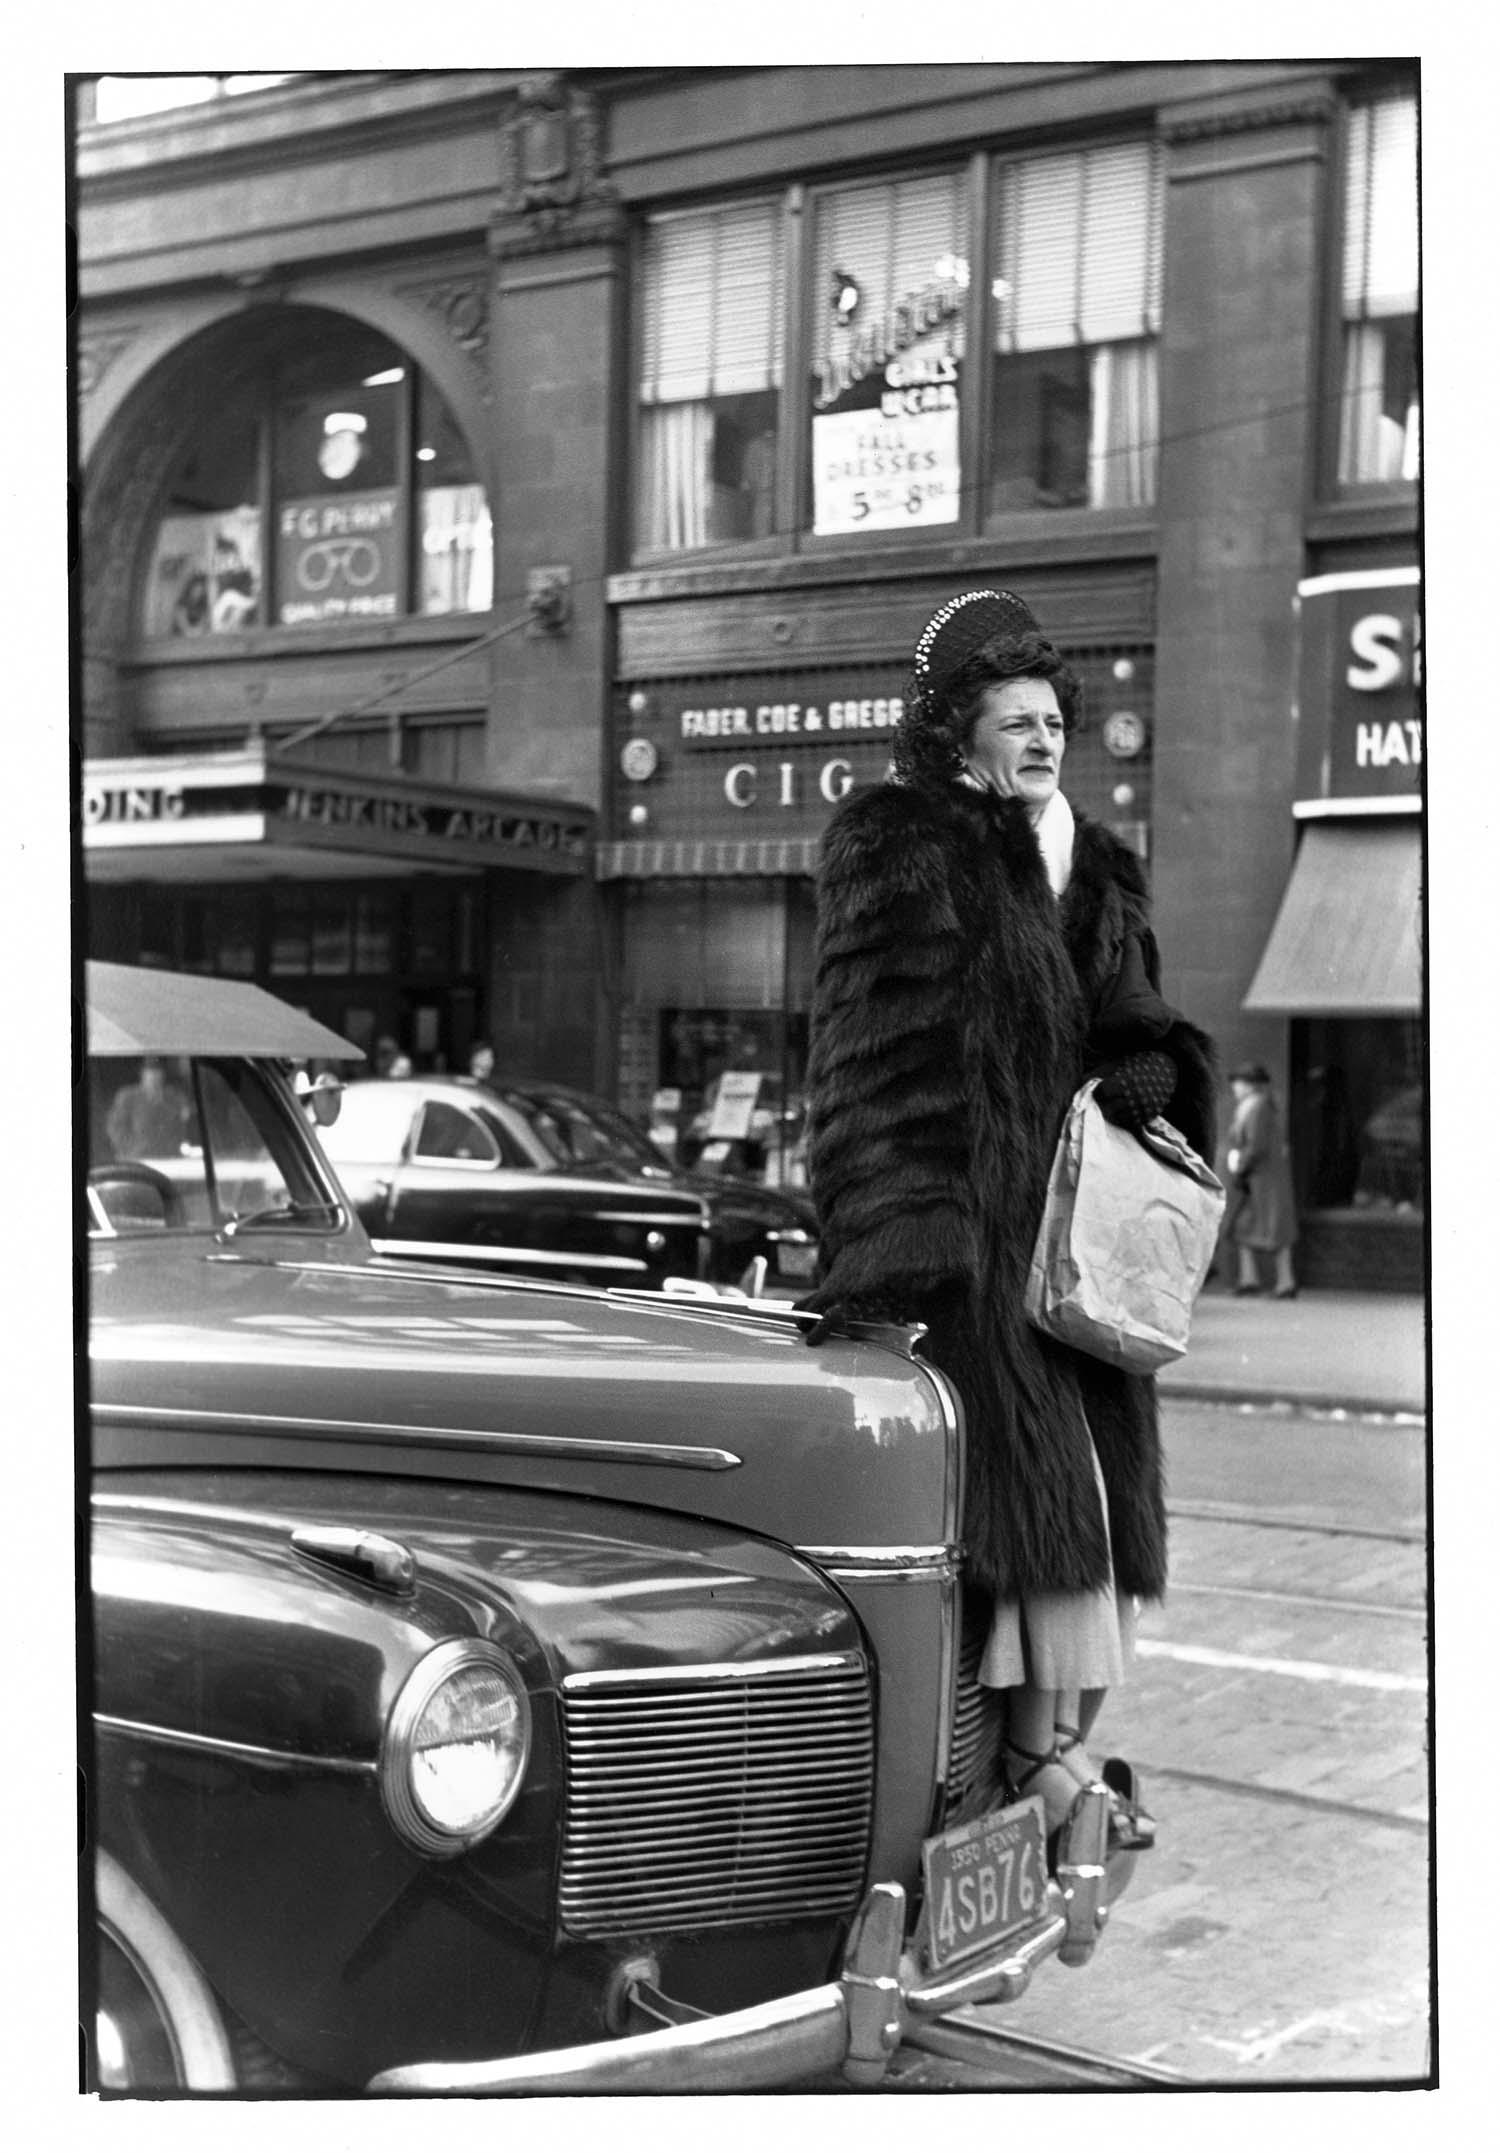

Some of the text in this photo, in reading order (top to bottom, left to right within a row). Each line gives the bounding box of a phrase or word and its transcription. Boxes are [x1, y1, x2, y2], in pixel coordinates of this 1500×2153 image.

[826, 451, 938, 481] DRESSES
[757, 704, 800, 734] COE
[804, 706, 822, 732] &
[286, 789, 583, 856] JENKINS ARCADE
[938, 1841, 1035, 1947] 4SB76
